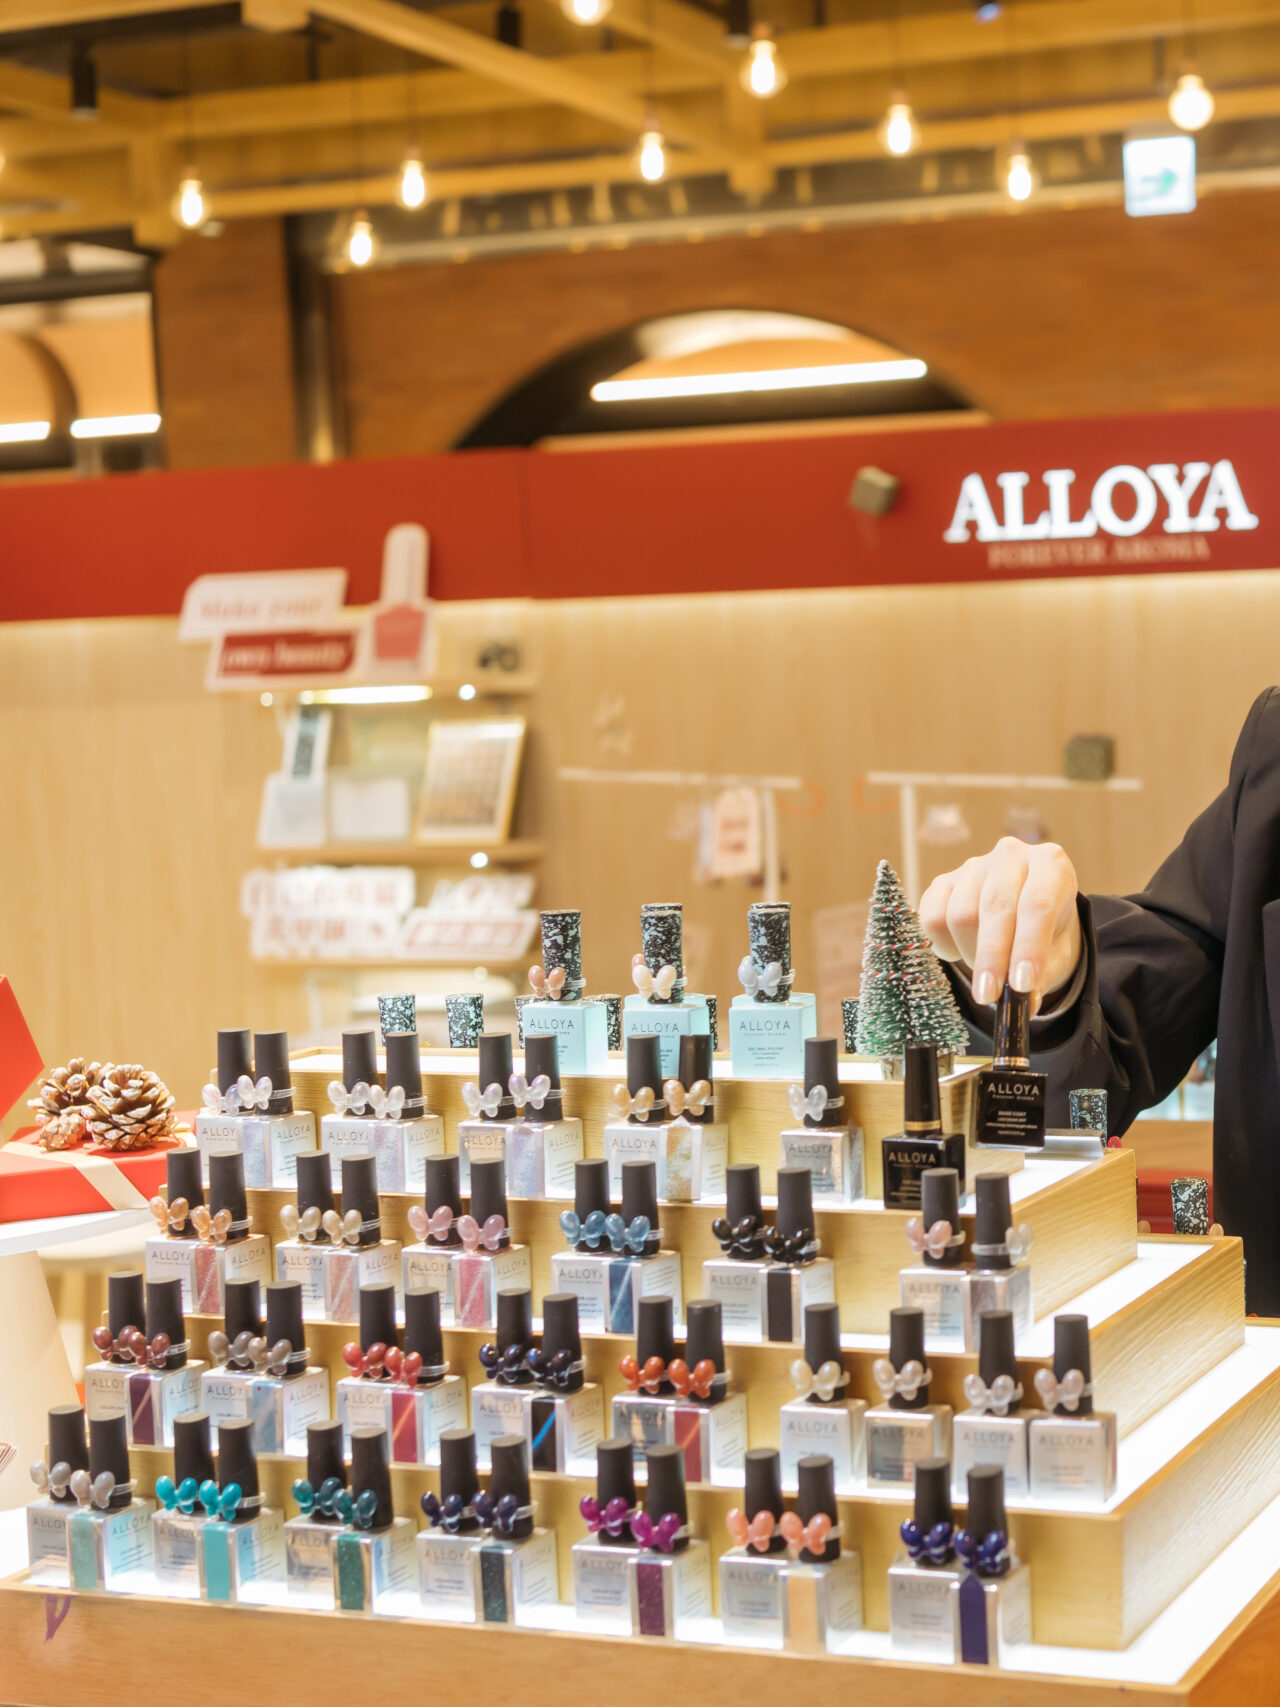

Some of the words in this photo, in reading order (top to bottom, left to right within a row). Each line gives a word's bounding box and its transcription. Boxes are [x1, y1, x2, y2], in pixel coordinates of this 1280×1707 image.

[943, 459, 1259, 543] ALLOYA
[530, 1019, 574, 1029] ALLOYA
[631, 1022, 679, 1033] ALLOYA
[739, 1020, 791, 1031] ALLOYA
[988, 1082, 1040, 1096] ALLOYA
[202, 1127, 236, 1137] ALLOY
[612, 1138, 656, 1149] ALLOYA
[888, 1151, 937, 1164] ALLOYA
[711, 1275, 758, 1286] ALLOYA
[92, 1378, 125, 1388] ALLOY
[207, 1385, 243, 1396] ALLOY
[787, 1421, 839, 1433] ALLOYA
[33, 1518, 66, 1529] ALLOY
